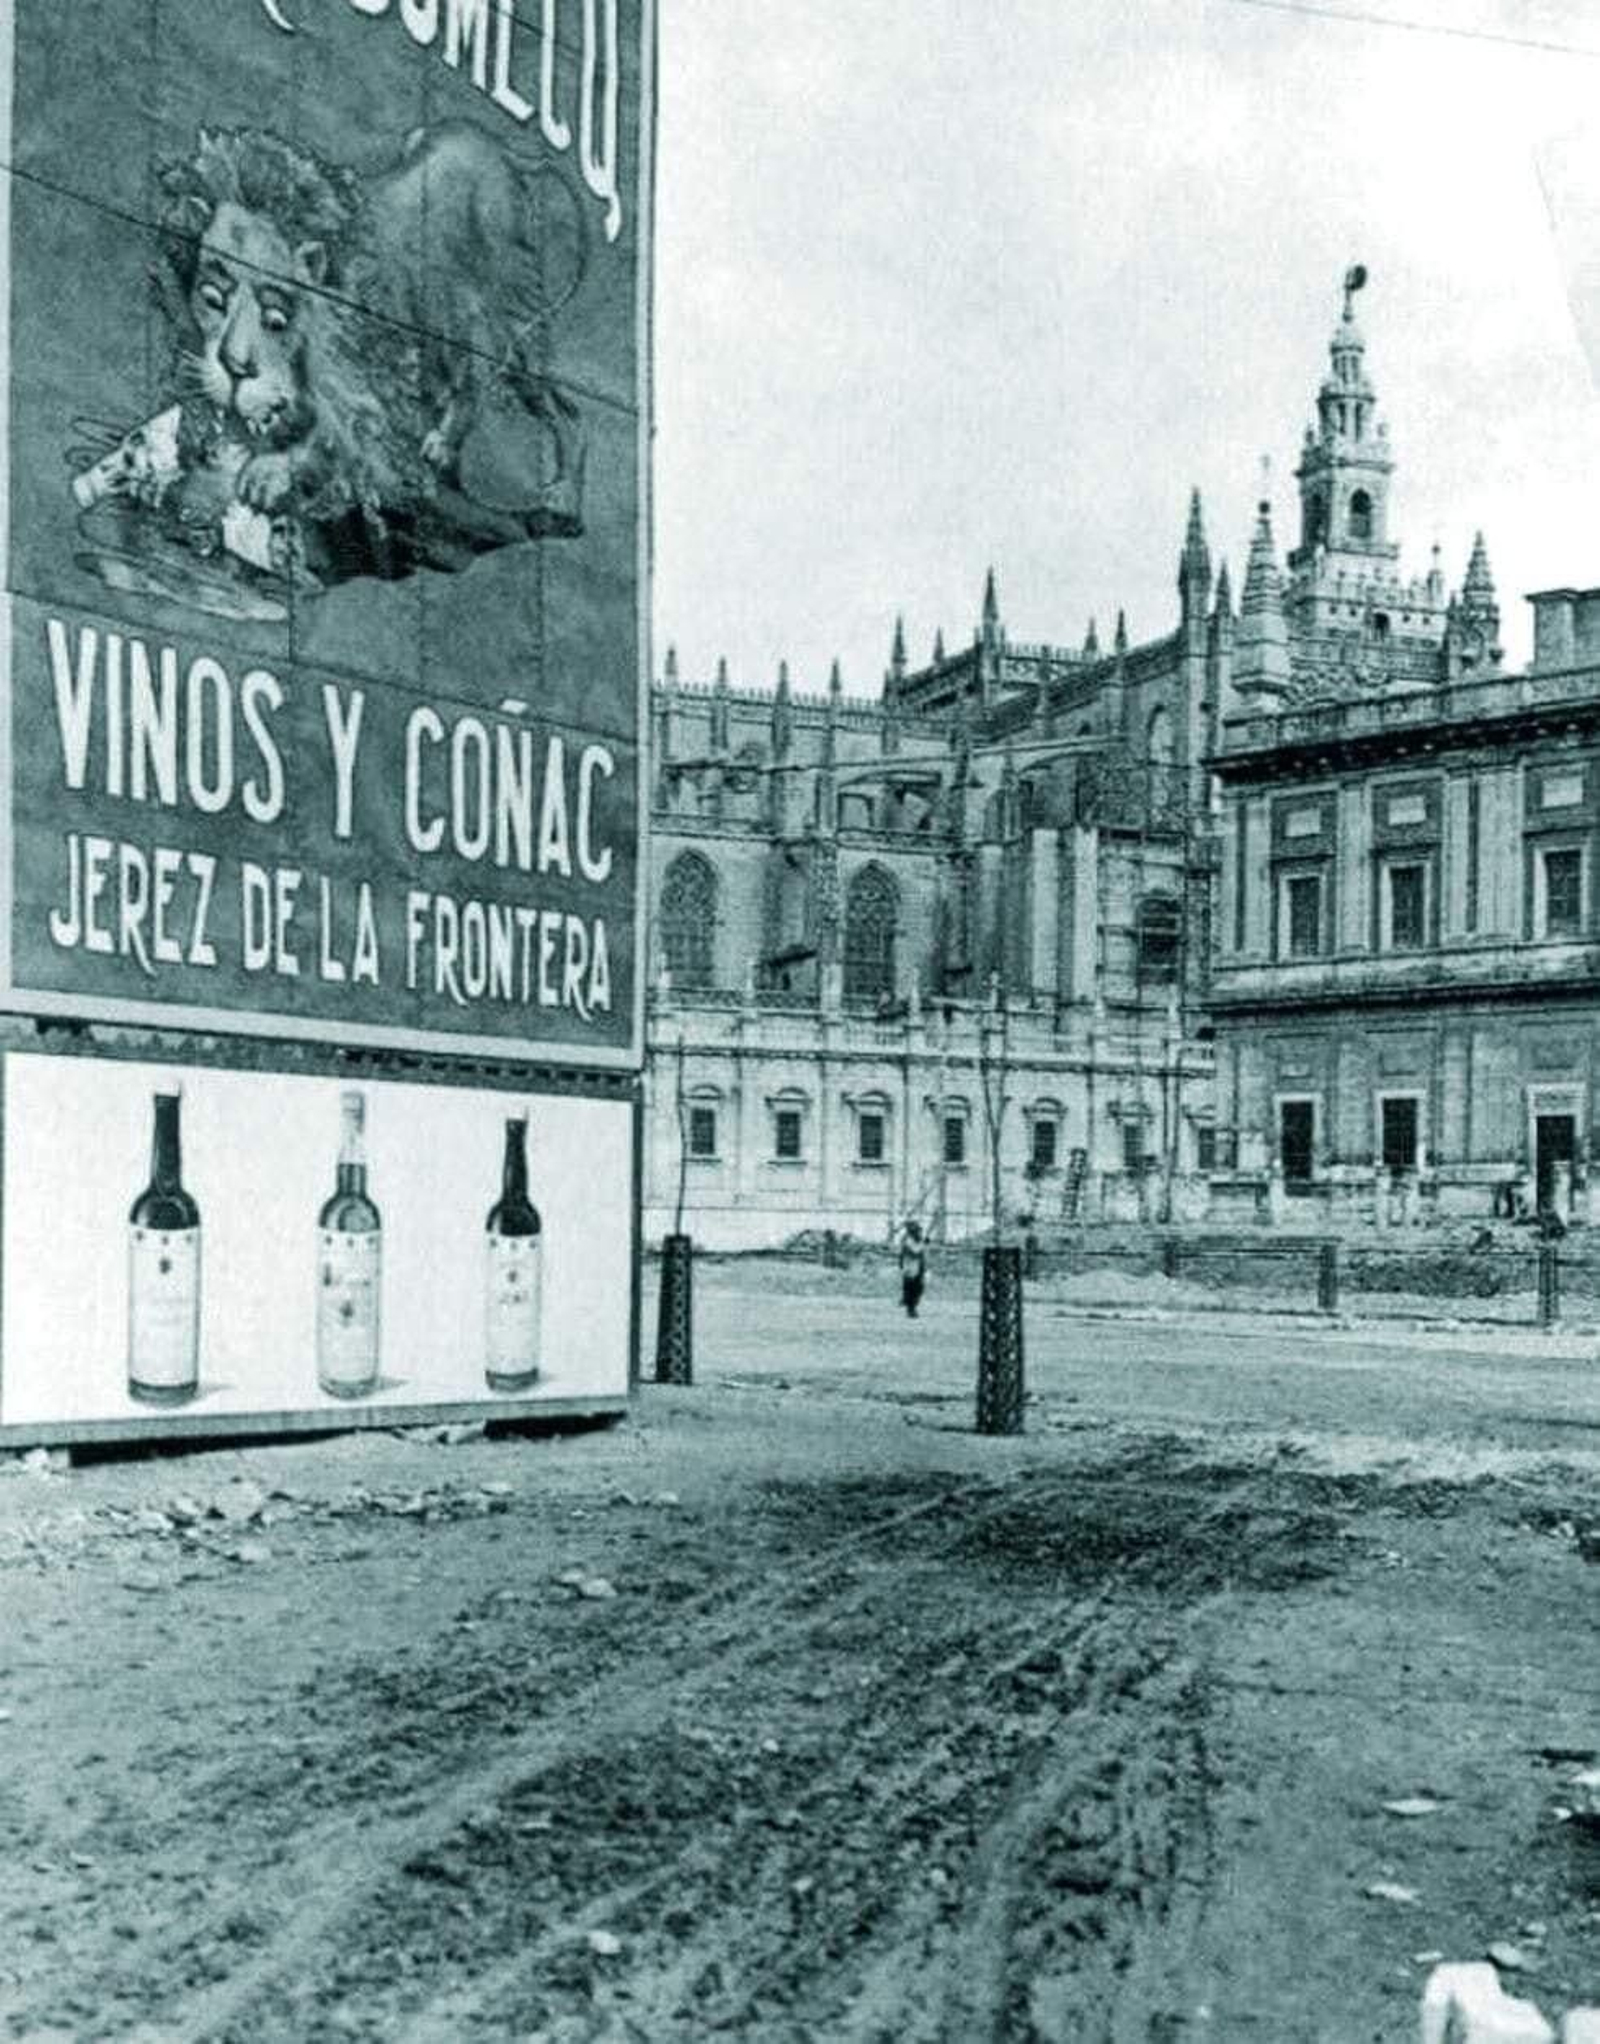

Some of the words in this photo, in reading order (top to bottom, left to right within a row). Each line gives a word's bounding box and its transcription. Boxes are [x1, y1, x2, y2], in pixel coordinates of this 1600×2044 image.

[47, 619, 284, 822] VINOS
[323, 684, 364, 837] Y
[405, 699, 613, 882] COÑAC
[50, 834, 216, 973] JEREZ
[243, 863, 302, 976] DE
[320, 876, 379, 985] LA
[406, 891, 611, 1021] FRONTERA
